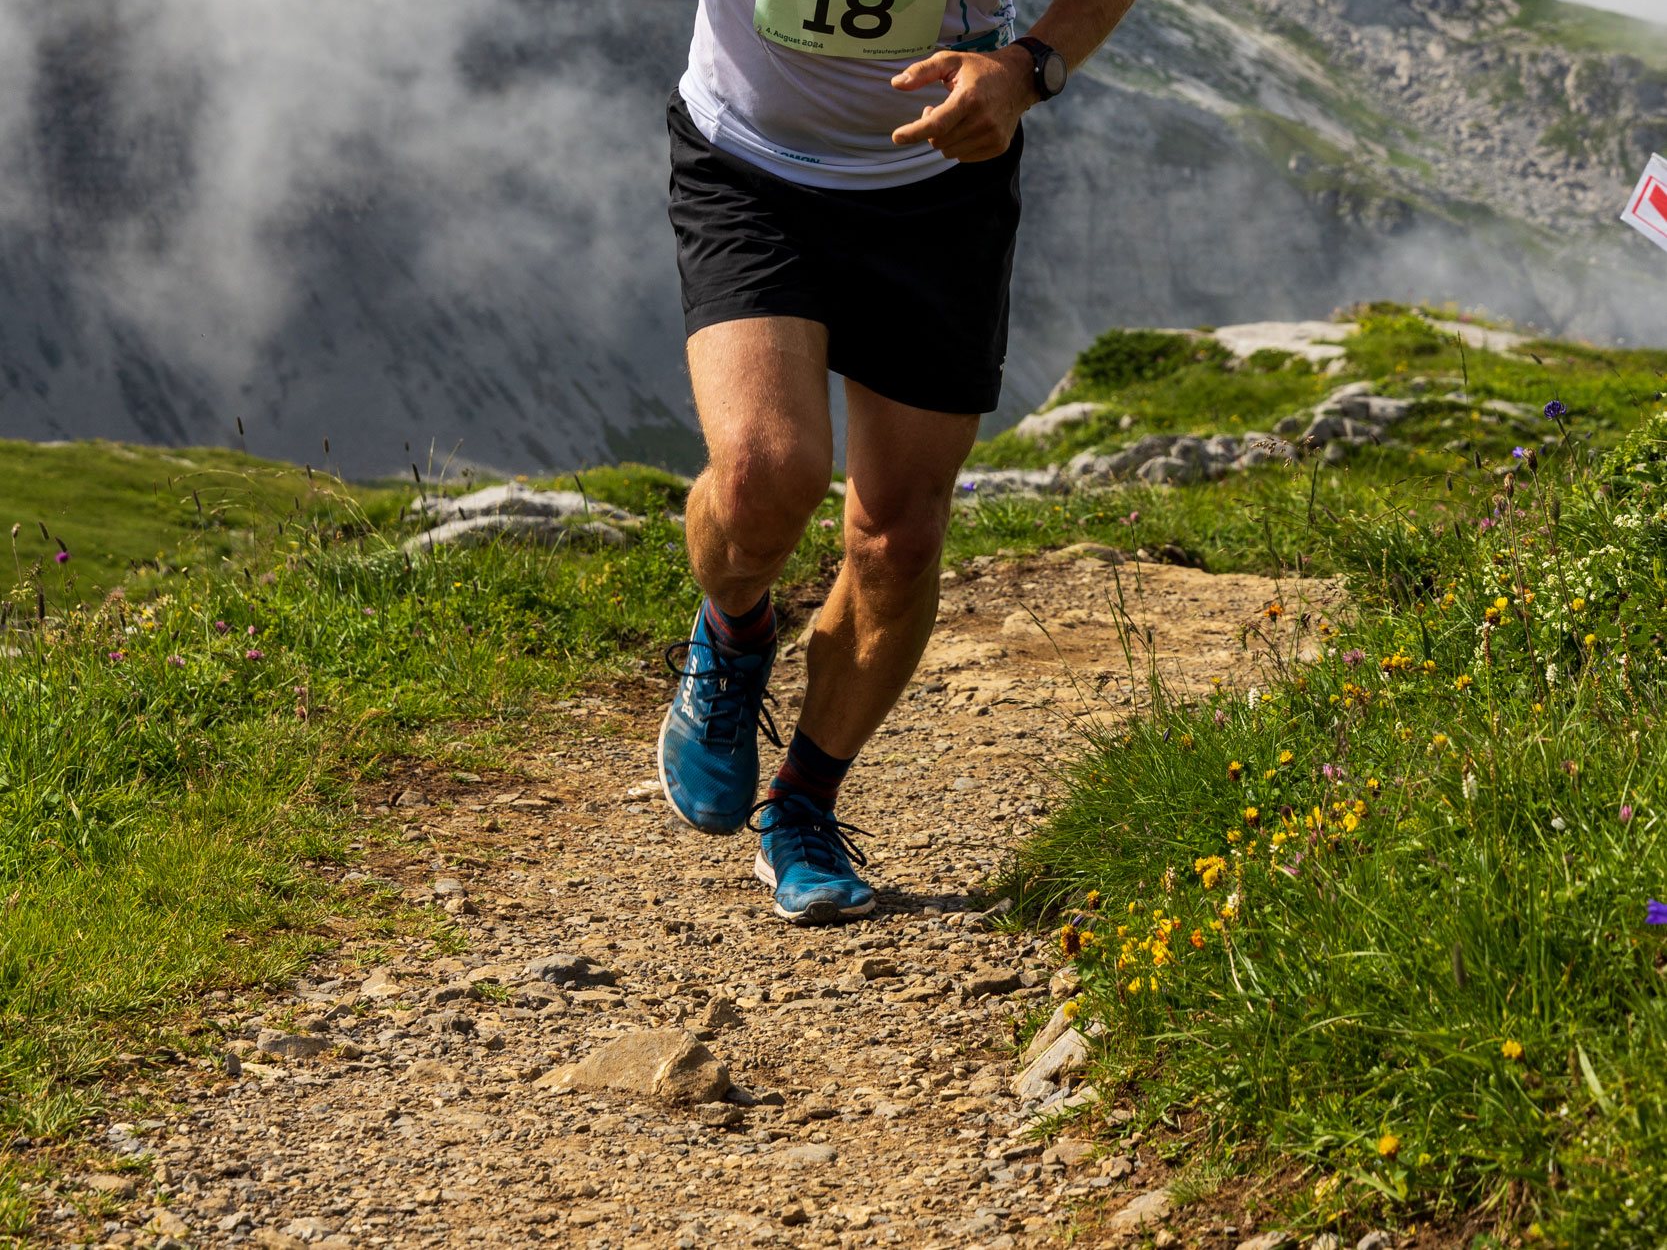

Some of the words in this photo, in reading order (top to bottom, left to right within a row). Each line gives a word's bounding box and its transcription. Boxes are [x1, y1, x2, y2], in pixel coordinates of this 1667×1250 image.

[765, 27, 773, 35] 4.
[773, 30, 801, 44] August
[801, 40, 824, 49] 2024
